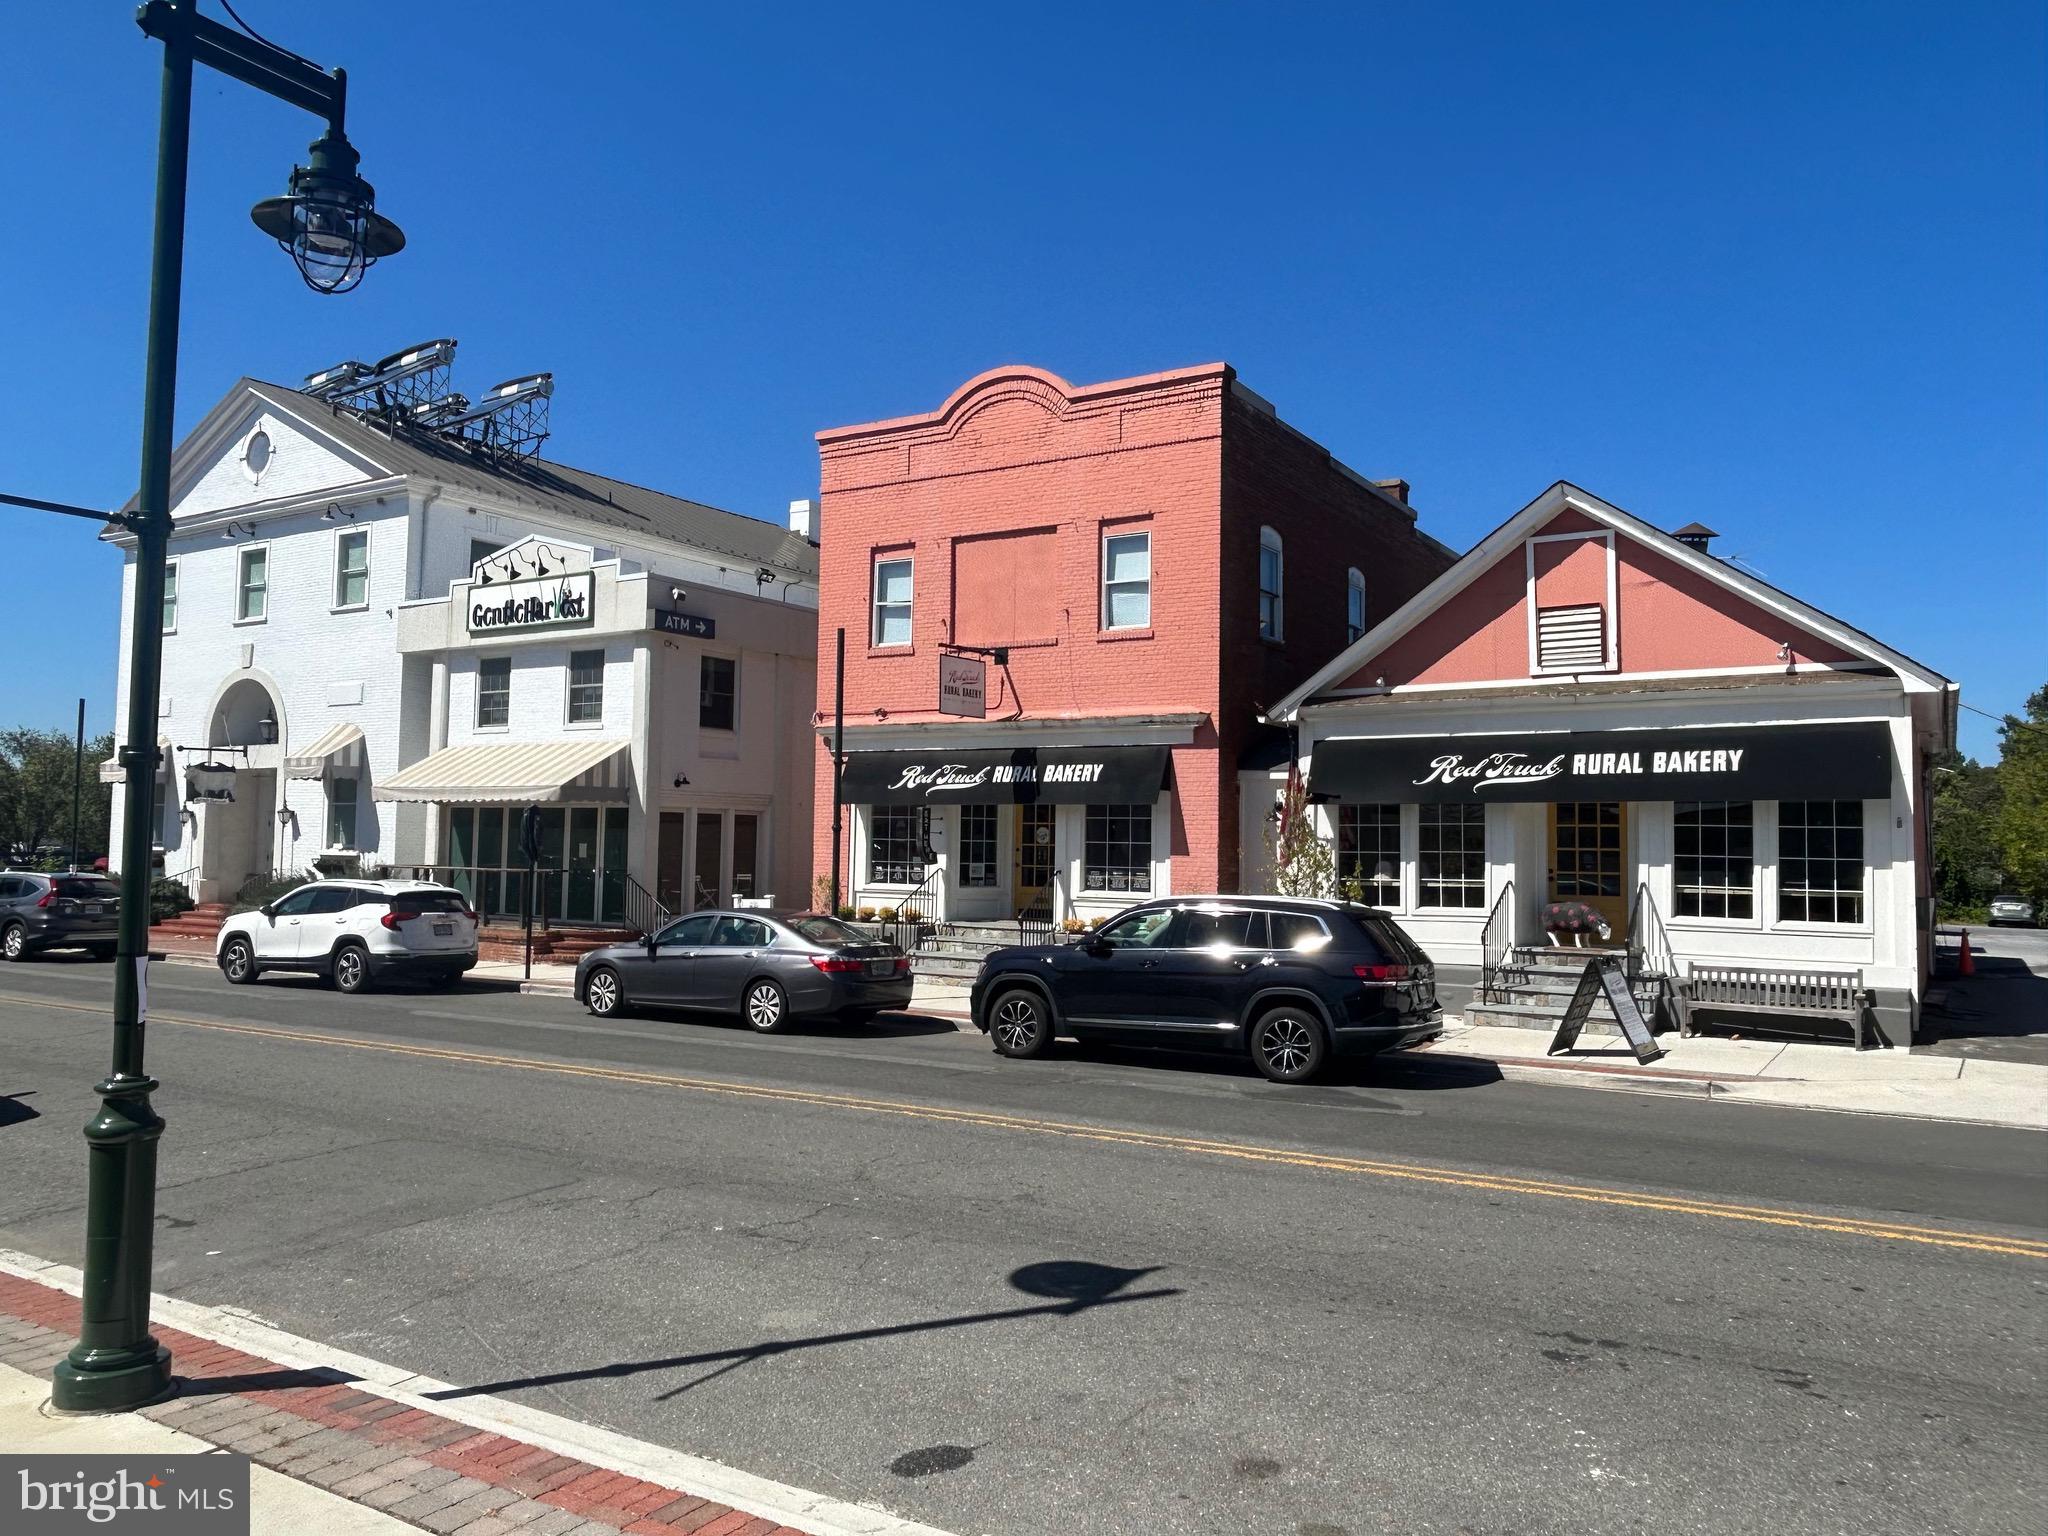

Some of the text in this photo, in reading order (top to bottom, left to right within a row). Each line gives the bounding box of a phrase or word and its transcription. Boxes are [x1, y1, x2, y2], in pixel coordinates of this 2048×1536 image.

[664, 614, 691, 632] ATM
[887, 763, 1104, 797] Red Truck RURAL BAKERY
[1412, 748, 1745, 794] Red Truck RURAL BAKERY
